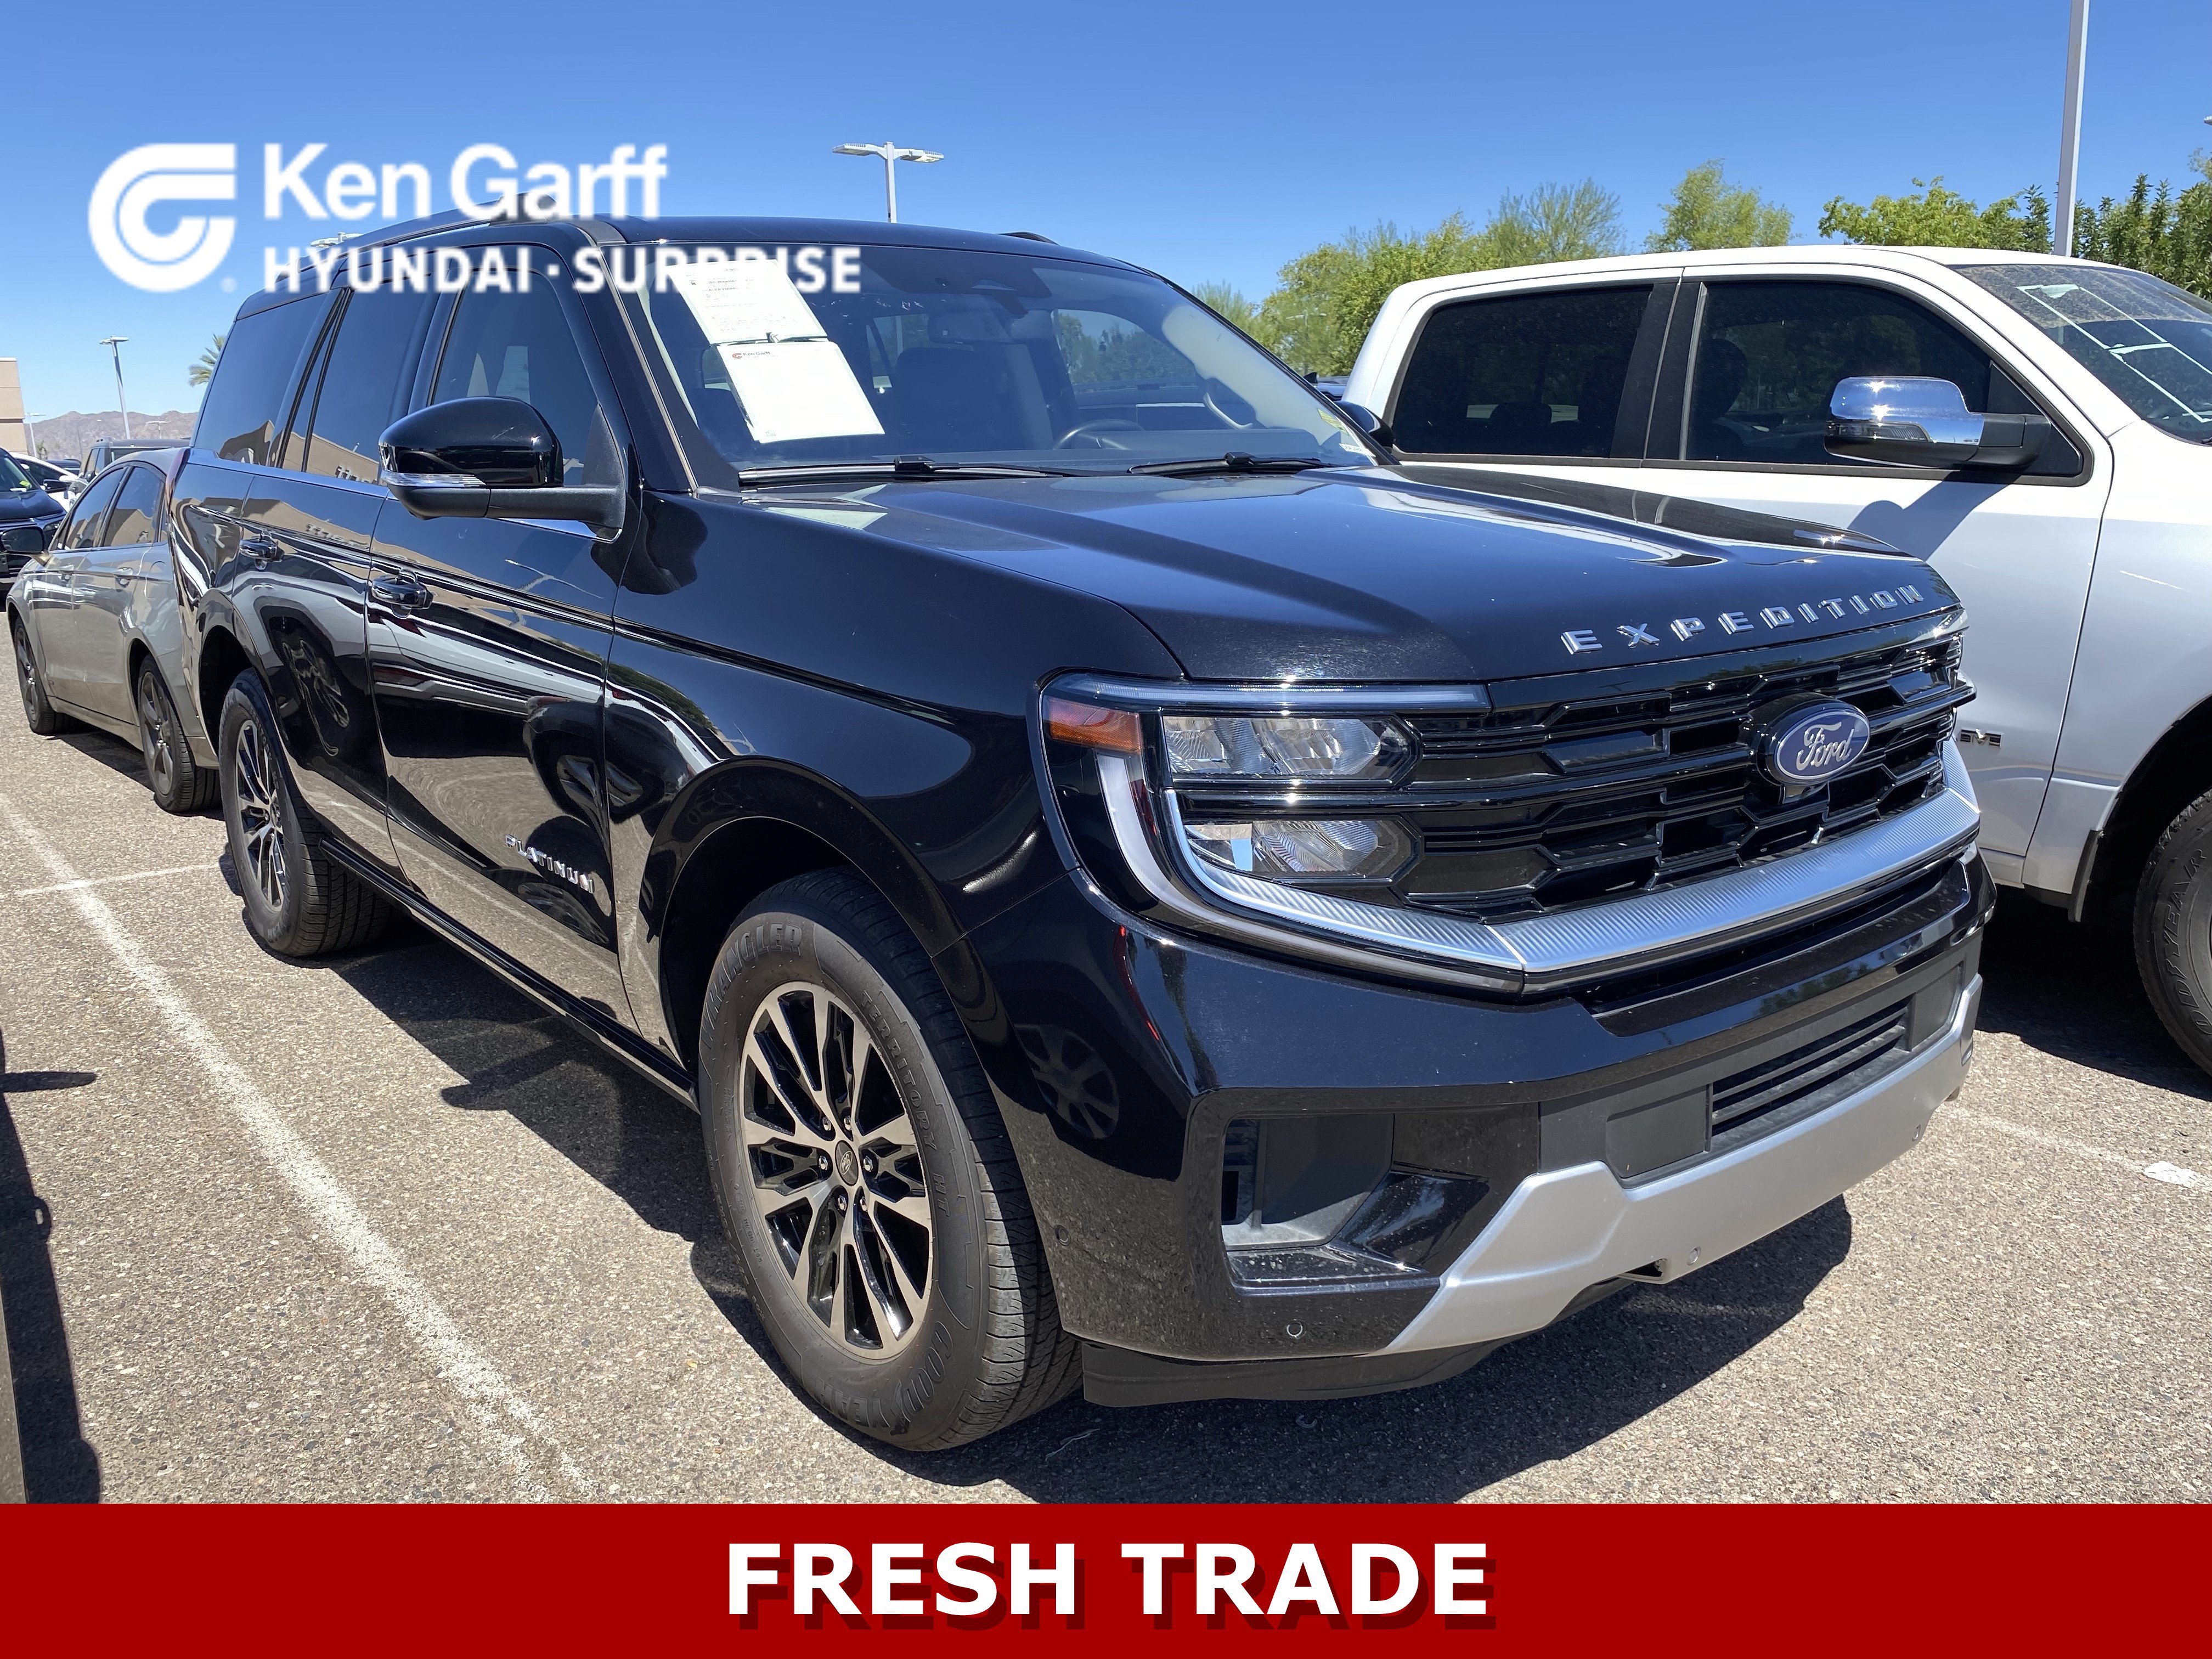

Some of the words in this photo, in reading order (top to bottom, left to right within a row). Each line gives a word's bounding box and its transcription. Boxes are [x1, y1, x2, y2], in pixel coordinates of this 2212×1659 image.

[1560, 584, 1925, 654] EXPEDITION
[1796, 721, 1855, 771] Ford
[505, 834, 595, 894] PLATINUM
[701, 922, 803, 1050] WRANGLER
[860, 989, 938, 1151] TERRITORY
[932, 1172, 950, 1217] HT
[814, 1320, 954, 1436] GOODYEAR
